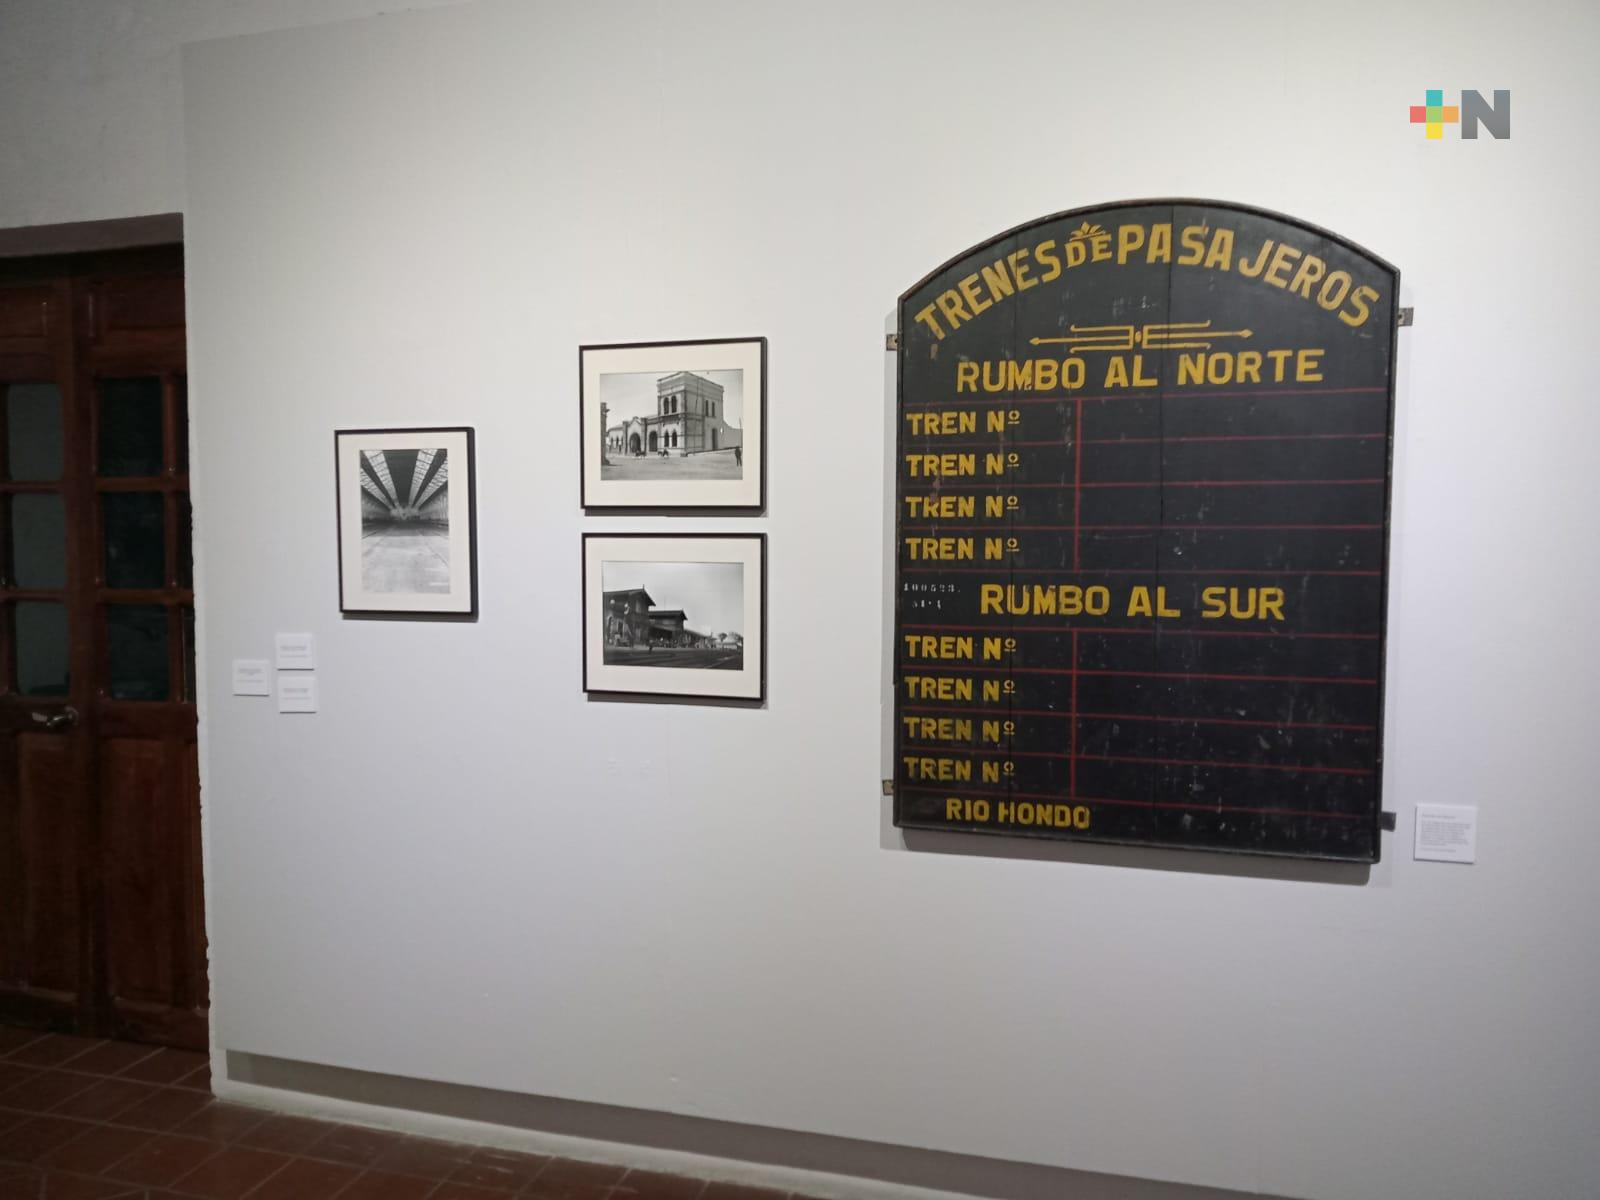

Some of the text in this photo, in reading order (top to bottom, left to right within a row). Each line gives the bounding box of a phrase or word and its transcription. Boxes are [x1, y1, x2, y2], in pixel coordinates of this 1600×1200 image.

[914, 239, 1062, 342] TRENES
[1066, 233, 1113, 268] DE
[956, 349, 1326, 393] RUMBO AL NORTE
[905, 411, 977, 435] TREN
[905, 453, 977, 477] TREN
[905, 495, 975, 518] TREN
[905, 537, 974, 560] TREN
[980, 584, 1286, 621] RUMBO AL SUR
[904, 635, 973, 659] TREN
[904, 676, 973, 701] TREN
[904, 717, 972, 741] TREN
[904, 757, 972, 781] TREN
[946, 798, 1091, 829] RIO HONDO
